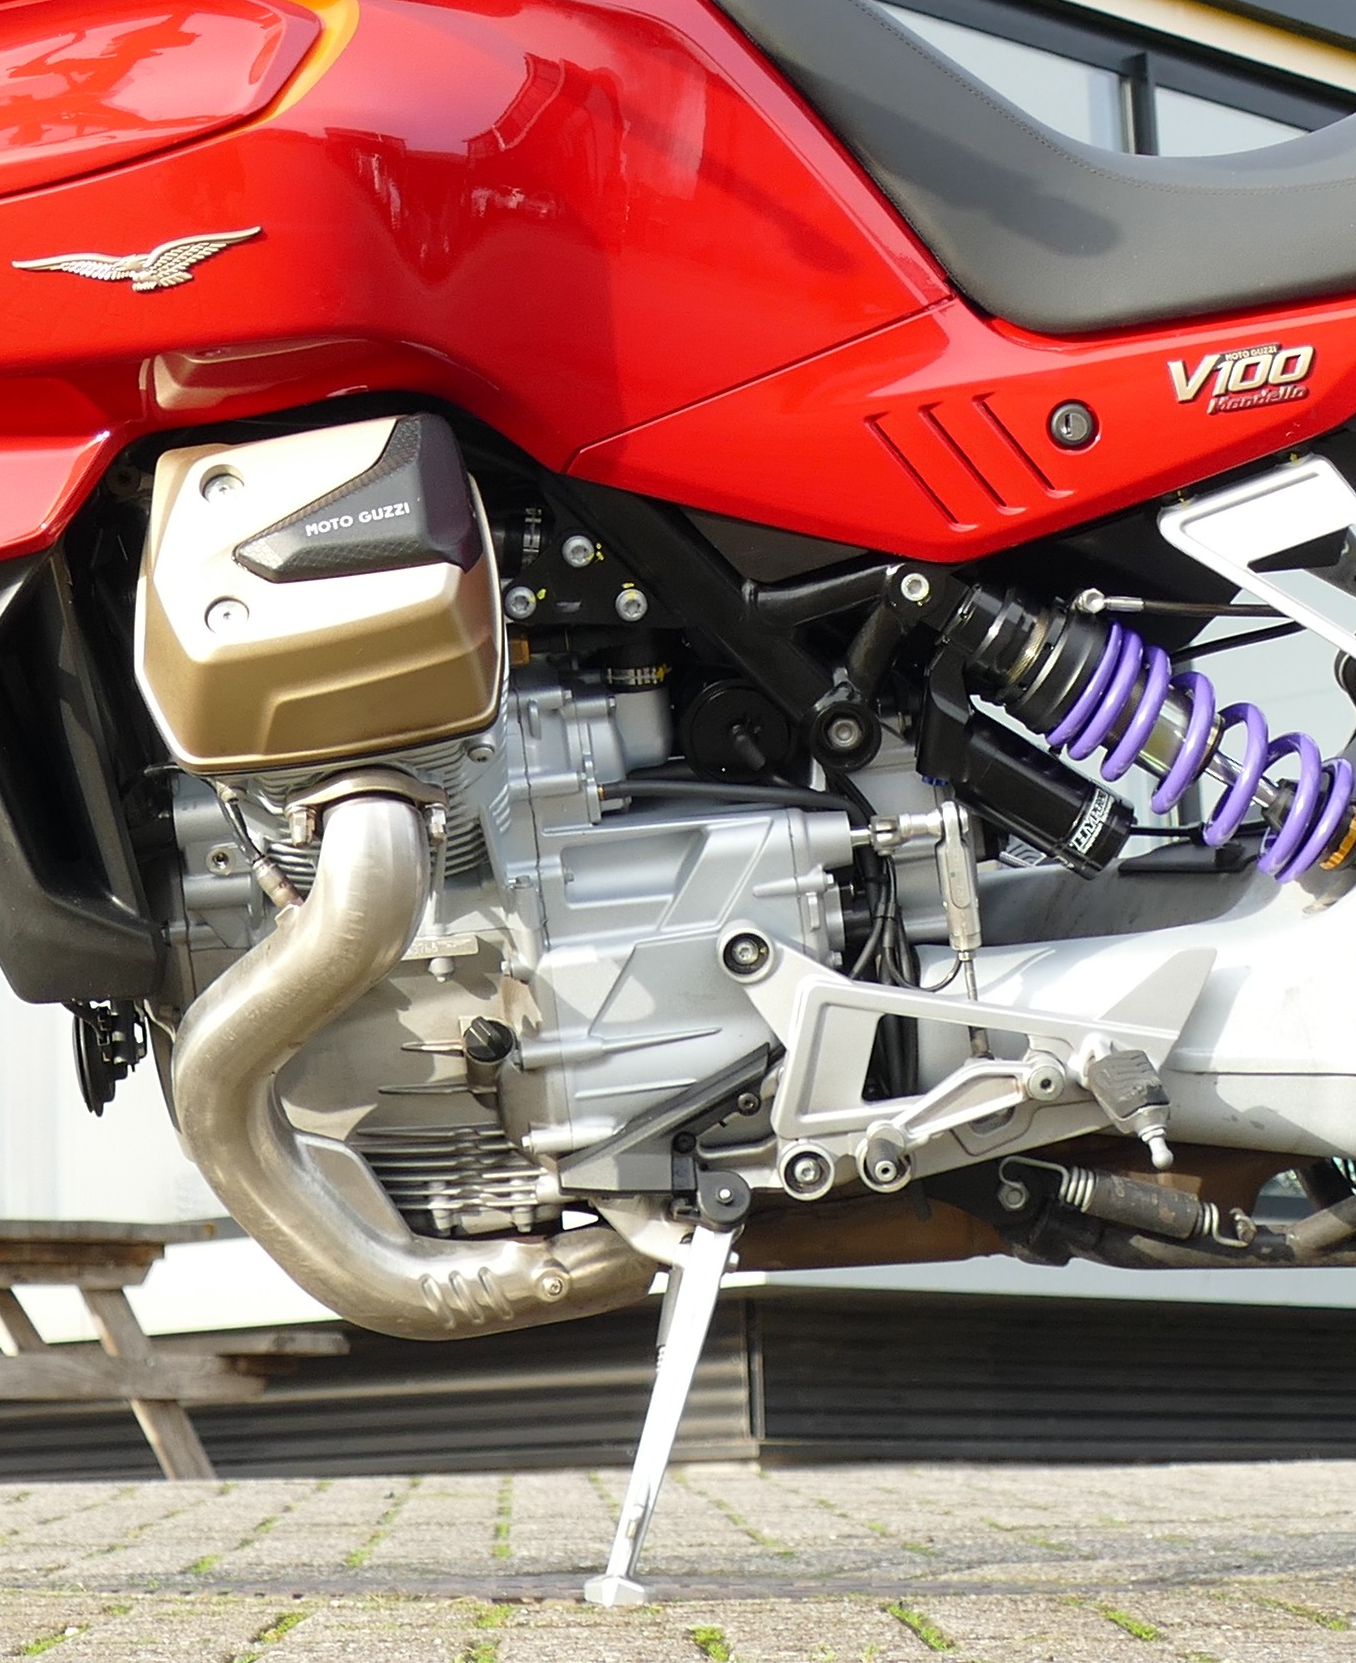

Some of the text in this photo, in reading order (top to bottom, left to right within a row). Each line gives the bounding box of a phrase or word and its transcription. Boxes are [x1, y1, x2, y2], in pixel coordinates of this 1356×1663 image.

[1168, 345, 1315, 403] V100
[305, 502, 410, 537] MOTO GUZZI
